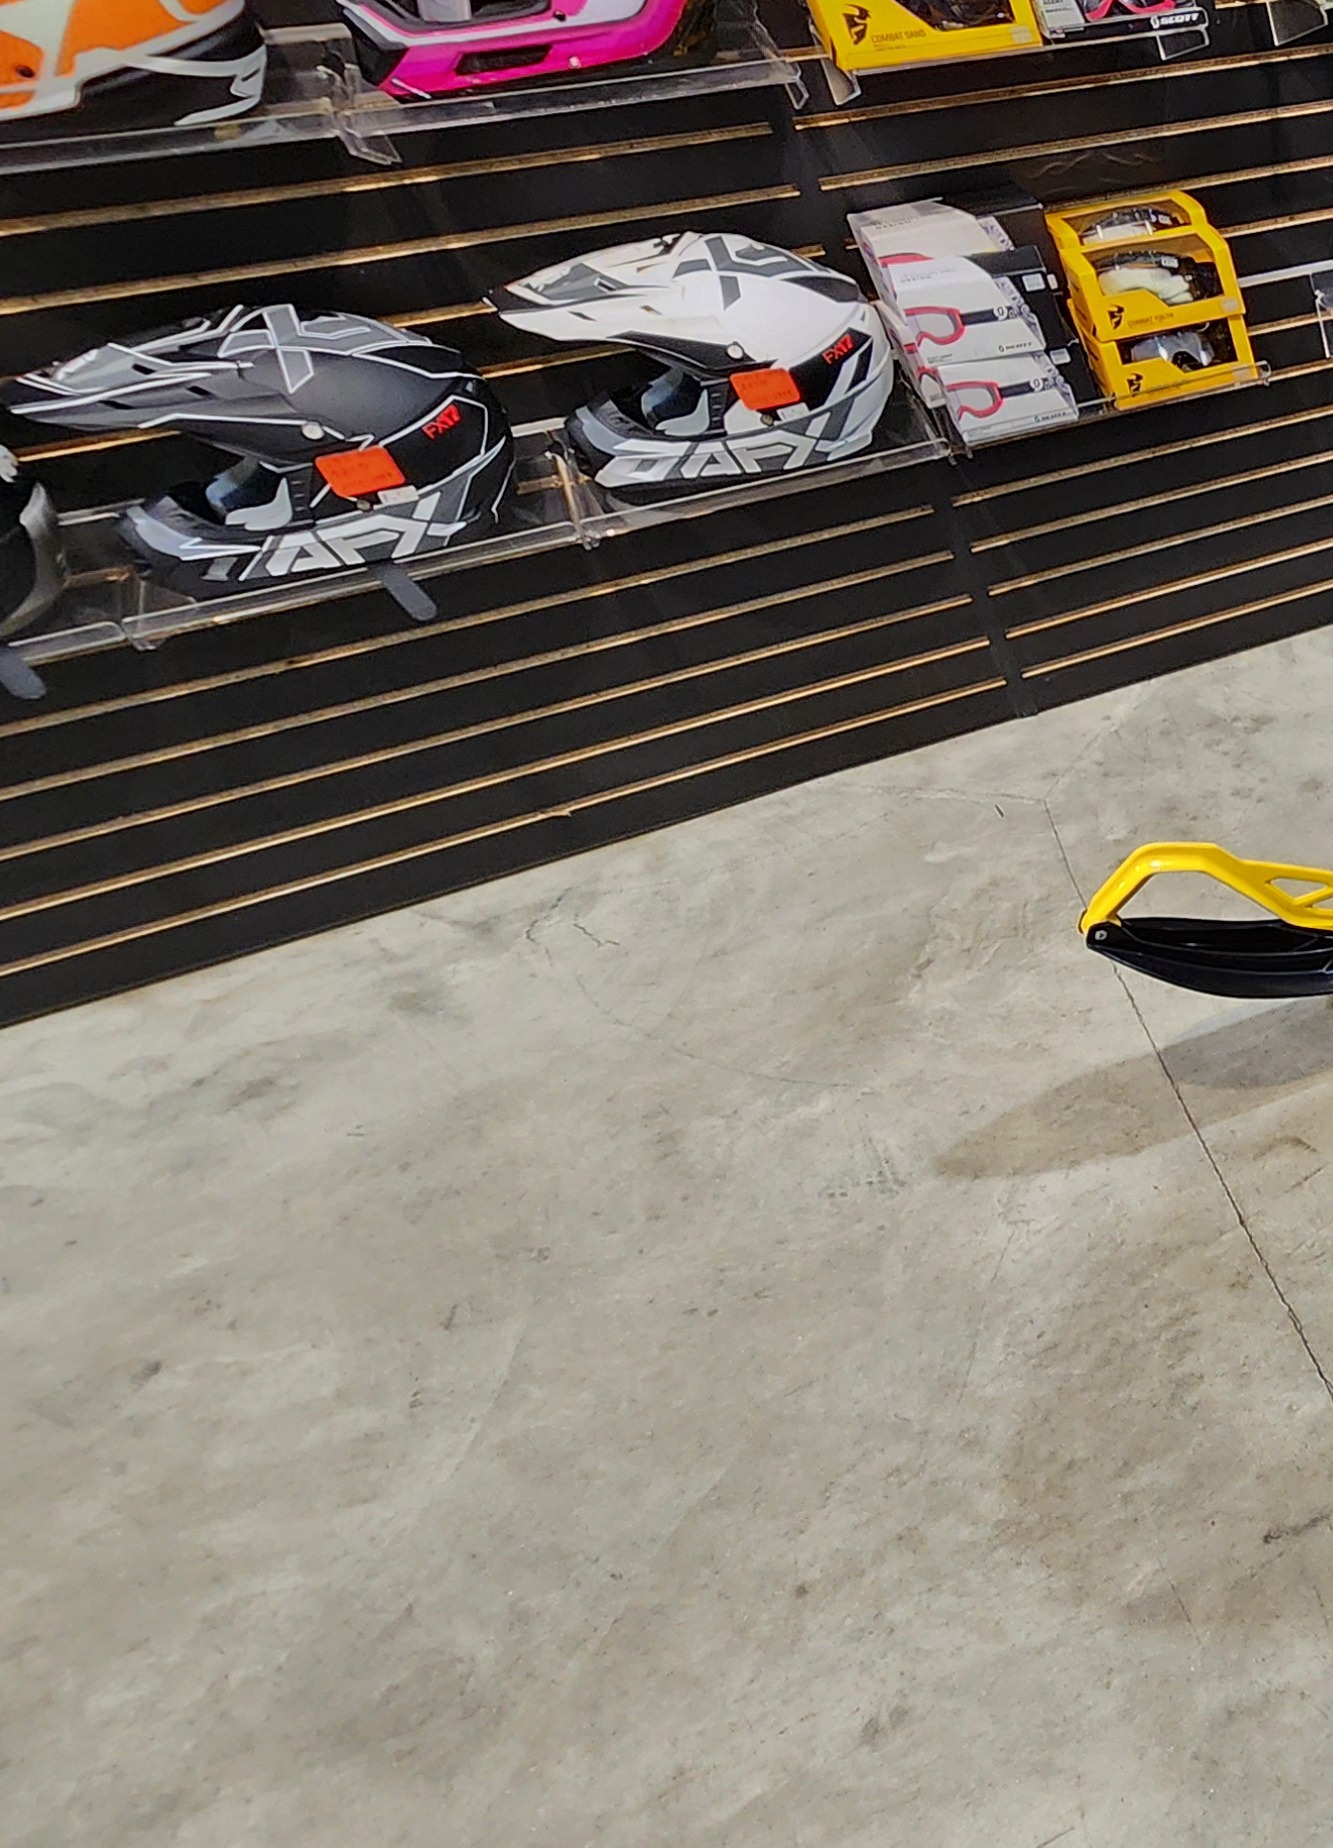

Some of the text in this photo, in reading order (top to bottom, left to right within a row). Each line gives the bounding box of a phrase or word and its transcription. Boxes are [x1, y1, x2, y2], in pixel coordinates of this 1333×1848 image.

[1160, 12, 1200, 25] SCOTT
[871, 28, 927, 44] COMBAT SAND
[822, 333, 853, 365] FX17
[422, 403, 462, 440] FX17
[680, 411, 853, 479] AFX
[264, 491, 467, 577] AFX
